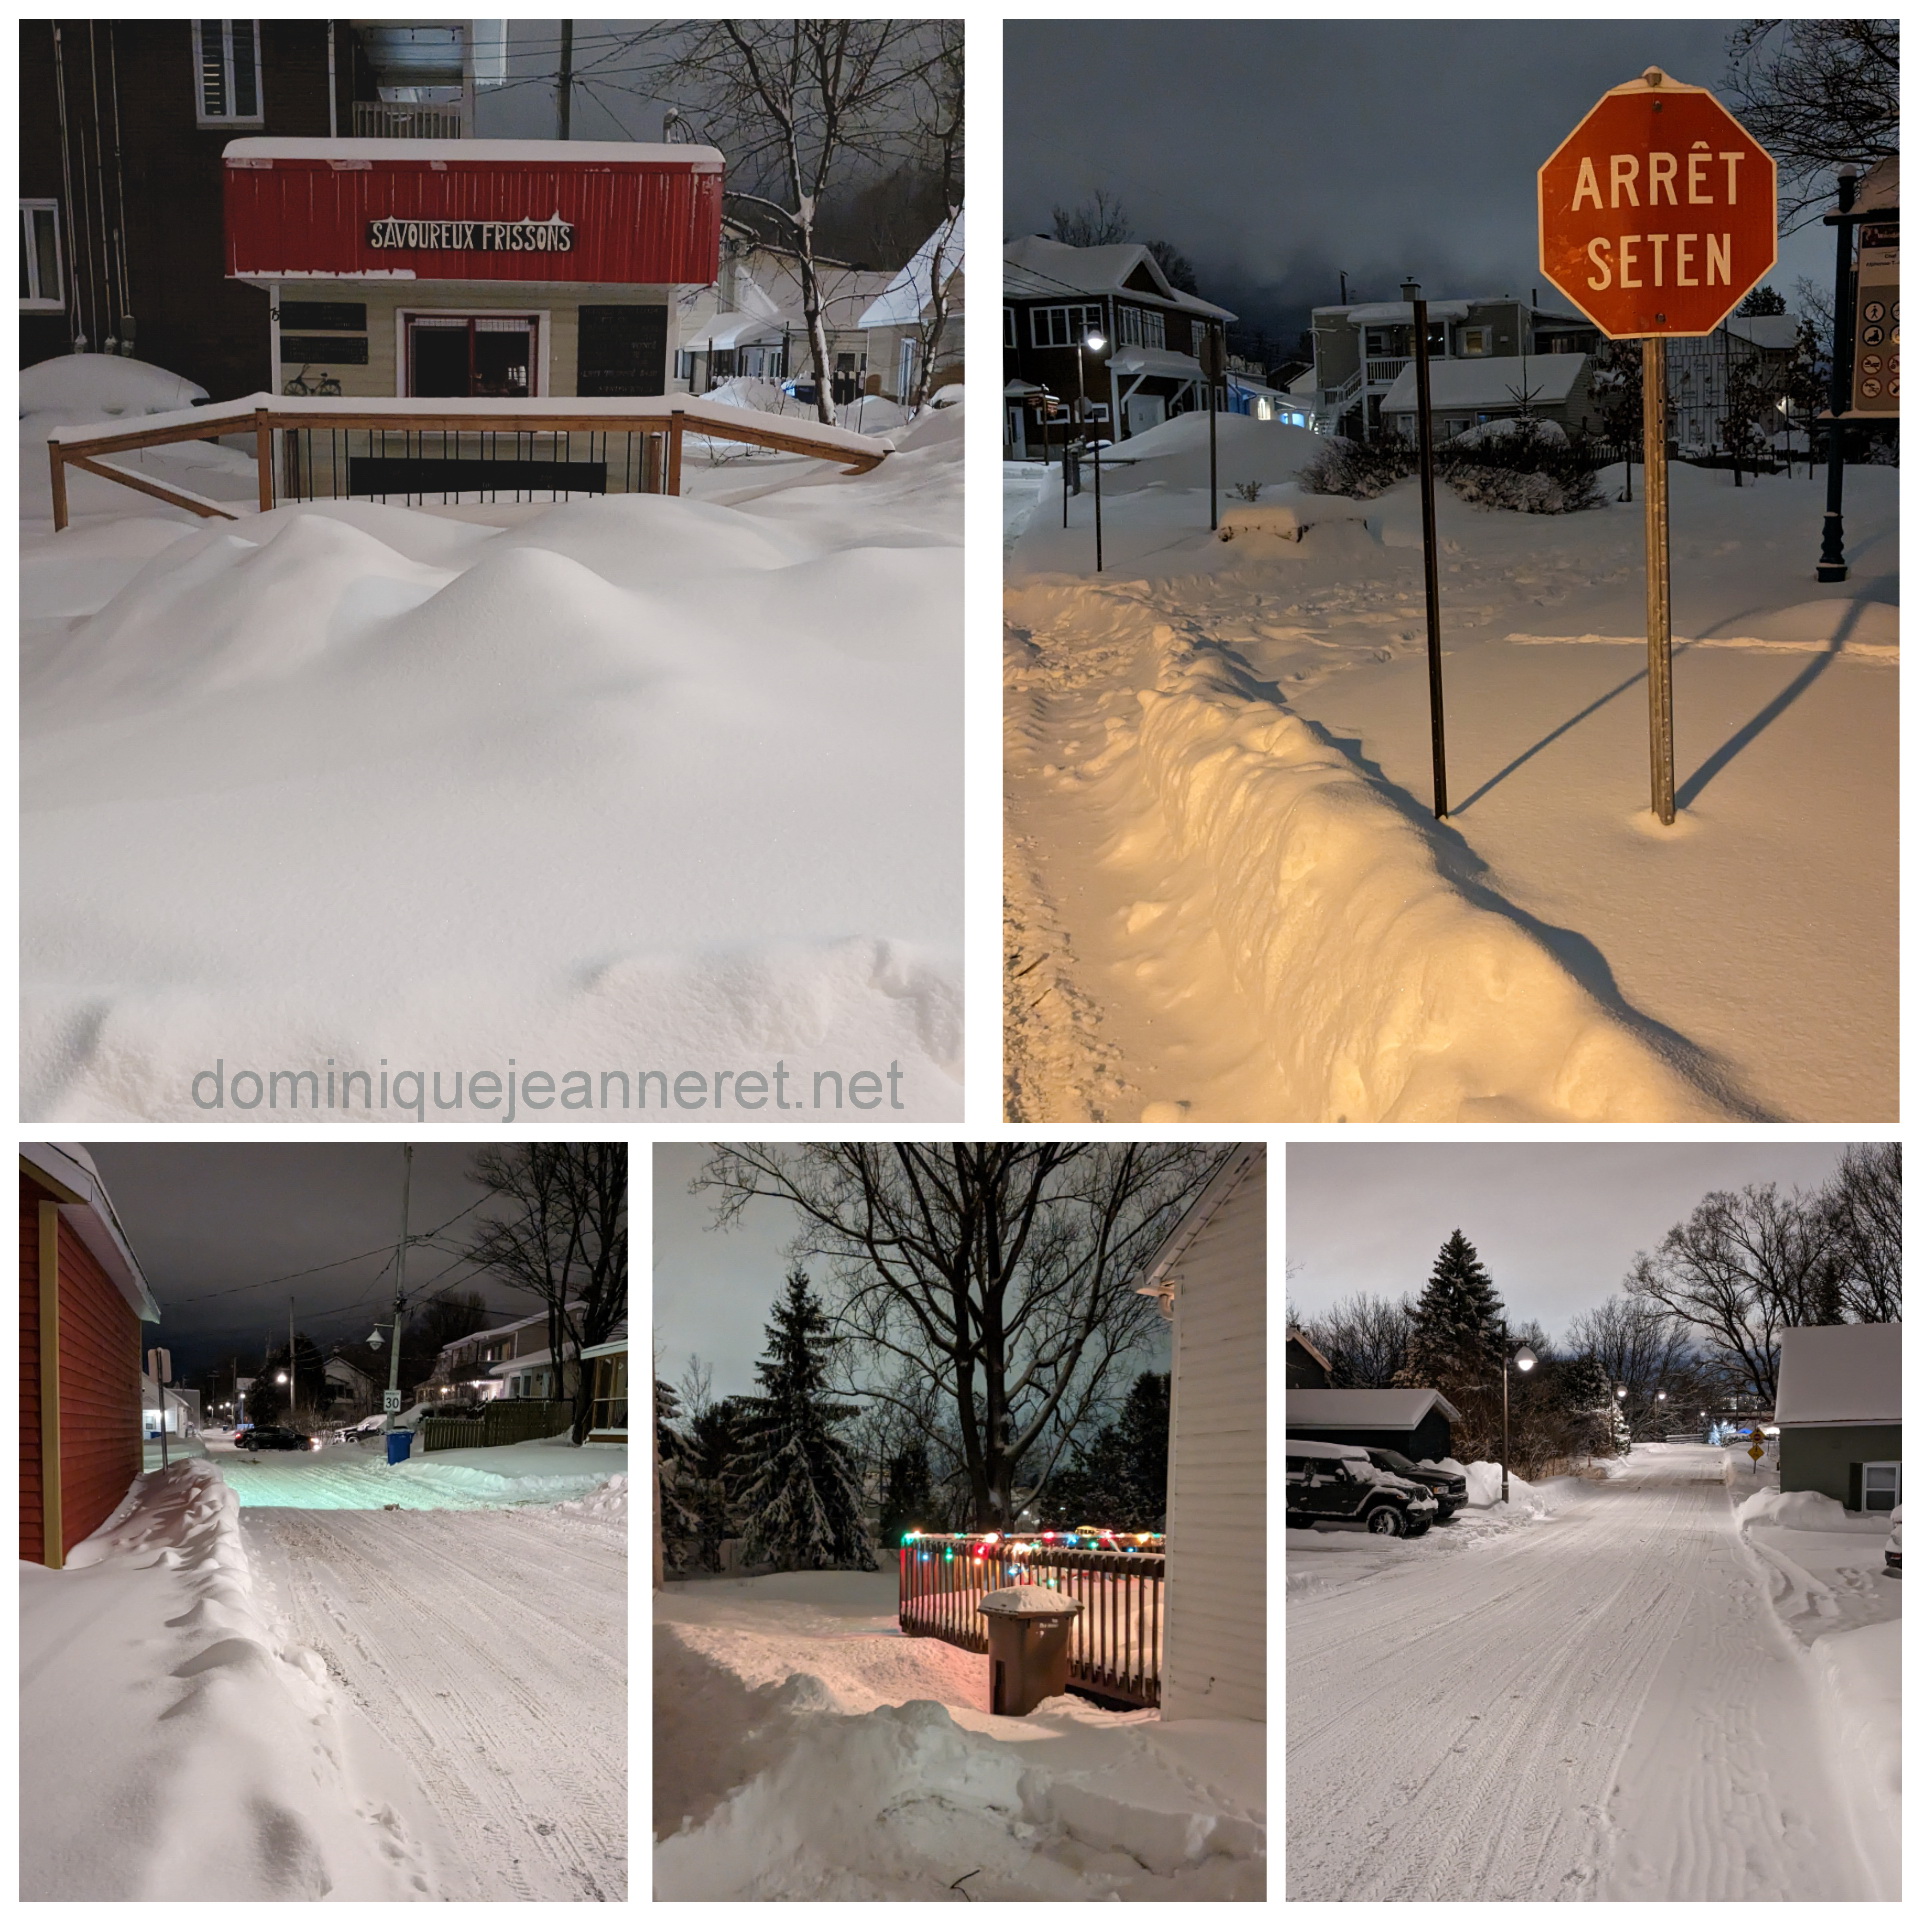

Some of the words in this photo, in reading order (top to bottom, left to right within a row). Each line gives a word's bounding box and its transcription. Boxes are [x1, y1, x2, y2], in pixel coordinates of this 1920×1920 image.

[1571, 141, 1745, 211] ARRÊT
[371, 222, 474, 249] SAVOUREUX
[483, 224, 571, 252] FRISSONS
[1587, 233, 1731, 291] SETEN
[385, 1397, 399, 1409] 30
